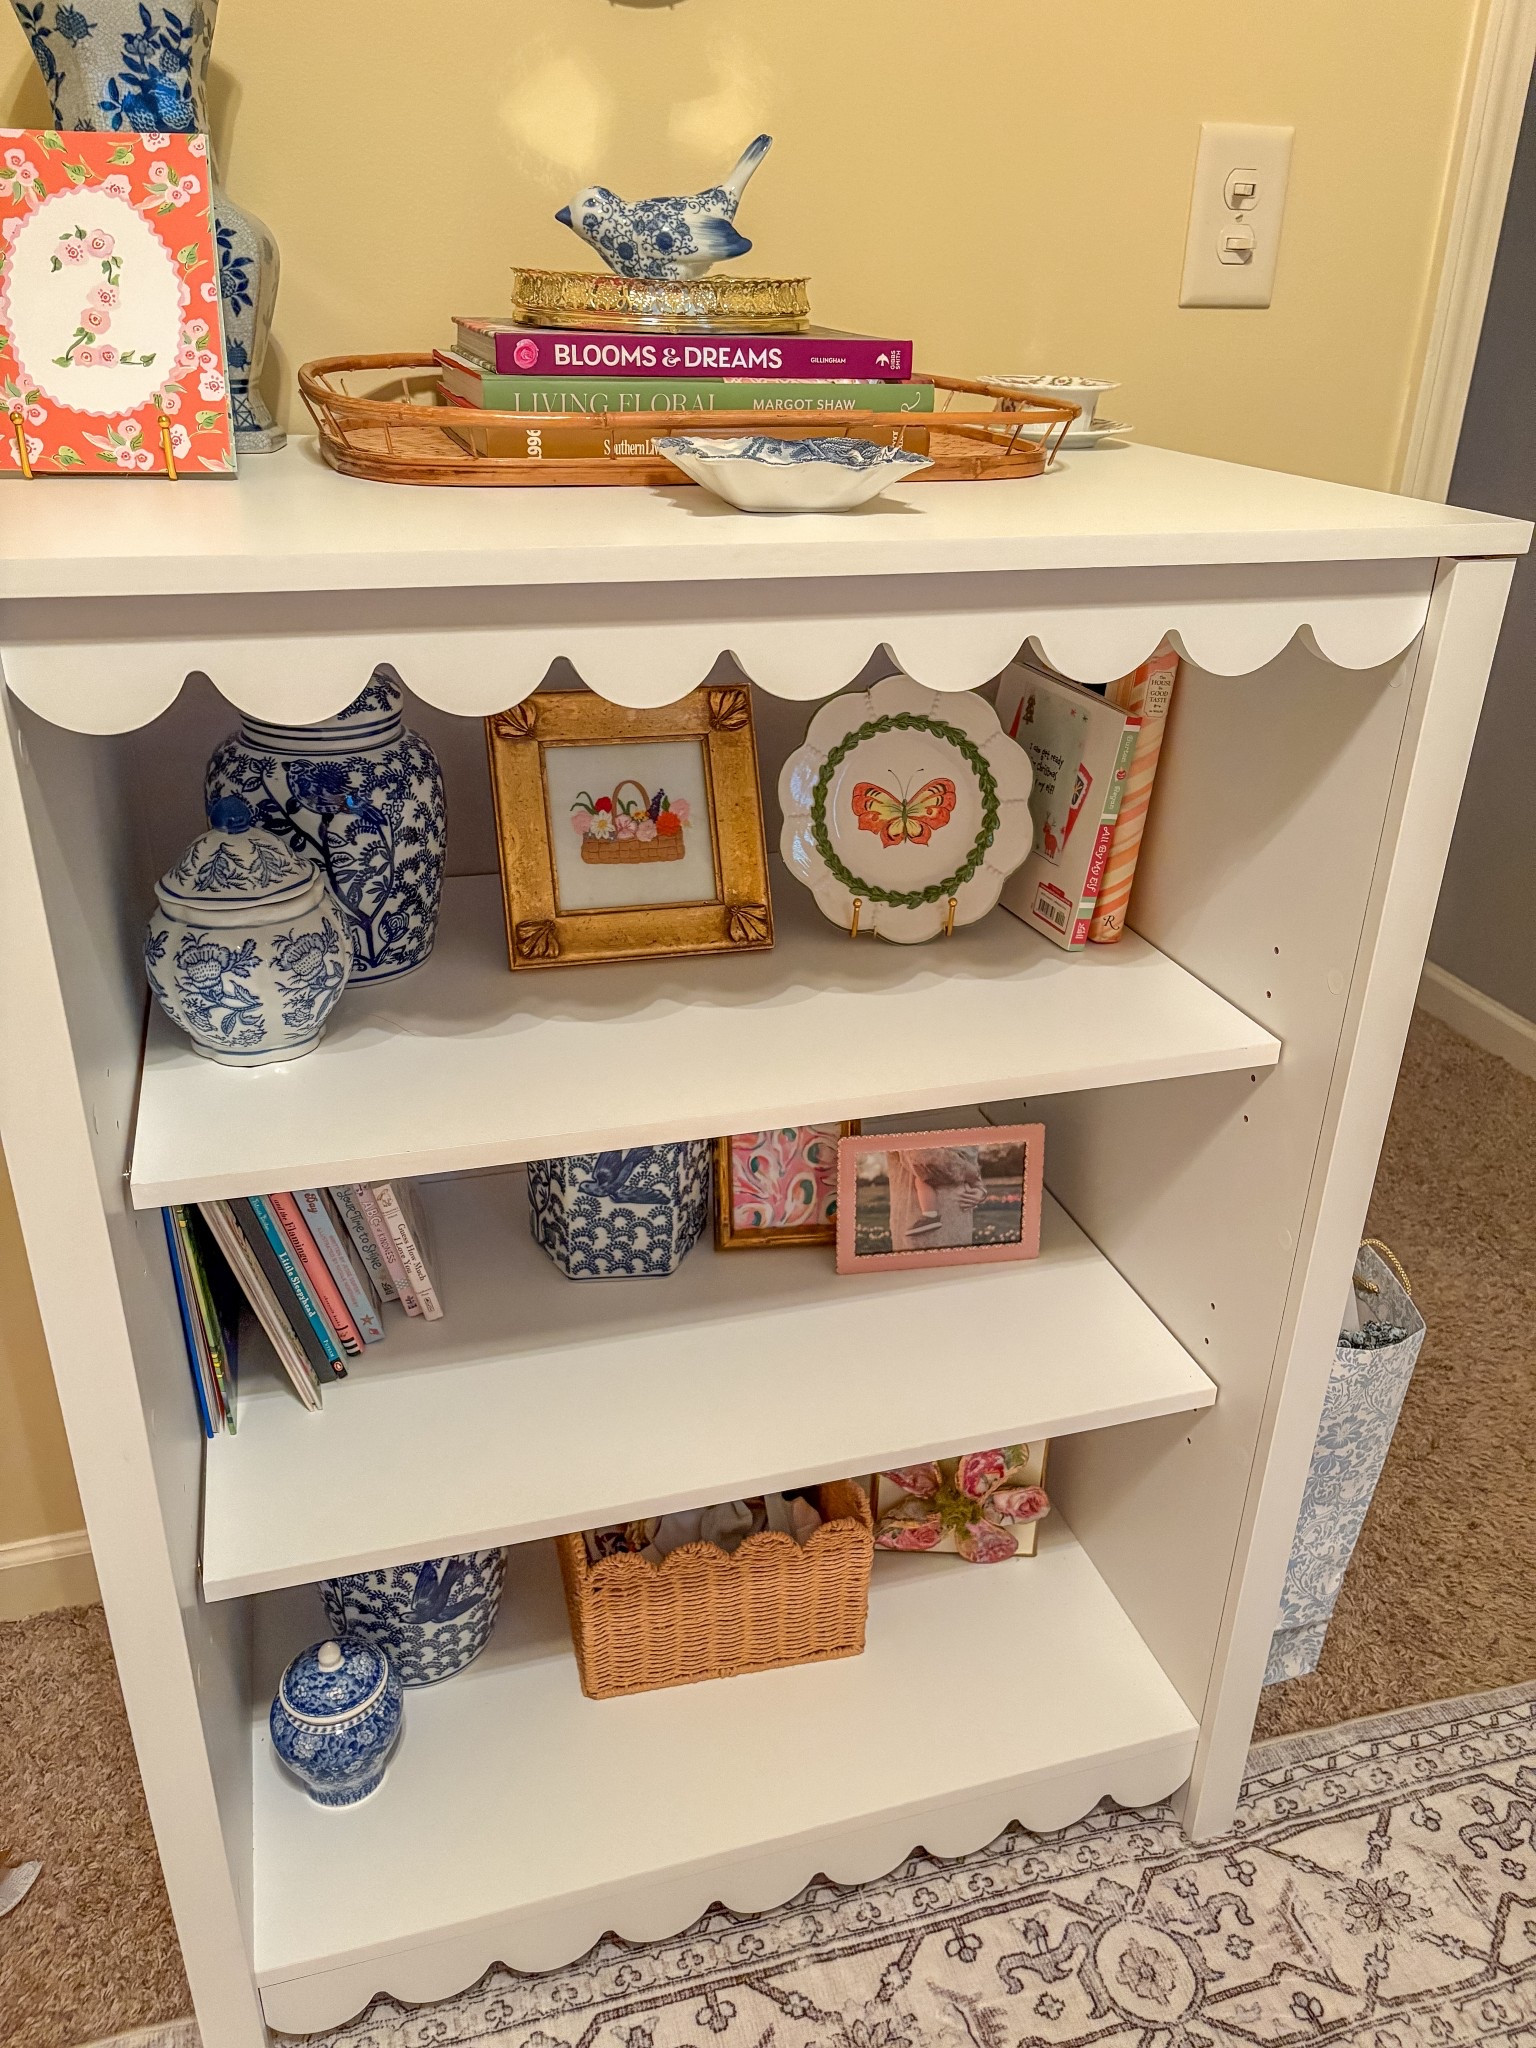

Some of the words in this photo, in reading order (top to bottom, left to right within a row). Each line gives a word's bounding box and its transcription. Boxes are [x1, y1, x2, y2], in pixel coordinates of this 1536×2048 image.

[554, 343, 657, 367] BLOOMS
[661, 347, 682, 369] &
[684, 346, 783, 369] DREAMS
[810, 356, 847, 365] GILLINGHAM
[513, 392, 609, 412] LIVING
[753, 399, 813, 411] MARGOT
[816, 399, 857, 411] SHAW
[603, 439, 645, 456] Southern
[1051, 754, 1065, 770] ready
[1100, 826, 1111, 843] All
[1094, 844, 1107, 860] By
[1091, 860, 1104, 876] My
[1086, 876, 1099, 893] Elf
[1103, 915, 1120, 931] R
[274, 1199, 285, 1211] and
[304, 1192, 318, 1214] Day
[279, 1211, 288, 1221] the
[361, 1201, 382, 1228] ABCs
[285, 1221, 309, 1264] Flamingo
[360, 1229, 370, 1244] to
[396, 1242, 406, 1259] Love
[403, 1258, 413, 1274] You
[397, 1223, 409, 1245] Guess
[406, 1243, 417, 1262] How
[413, 1261, 427, 1281] Much
[278, 1252, 293, 1277] Little
[290, 1274, 317, 1318] Sleepyhead
